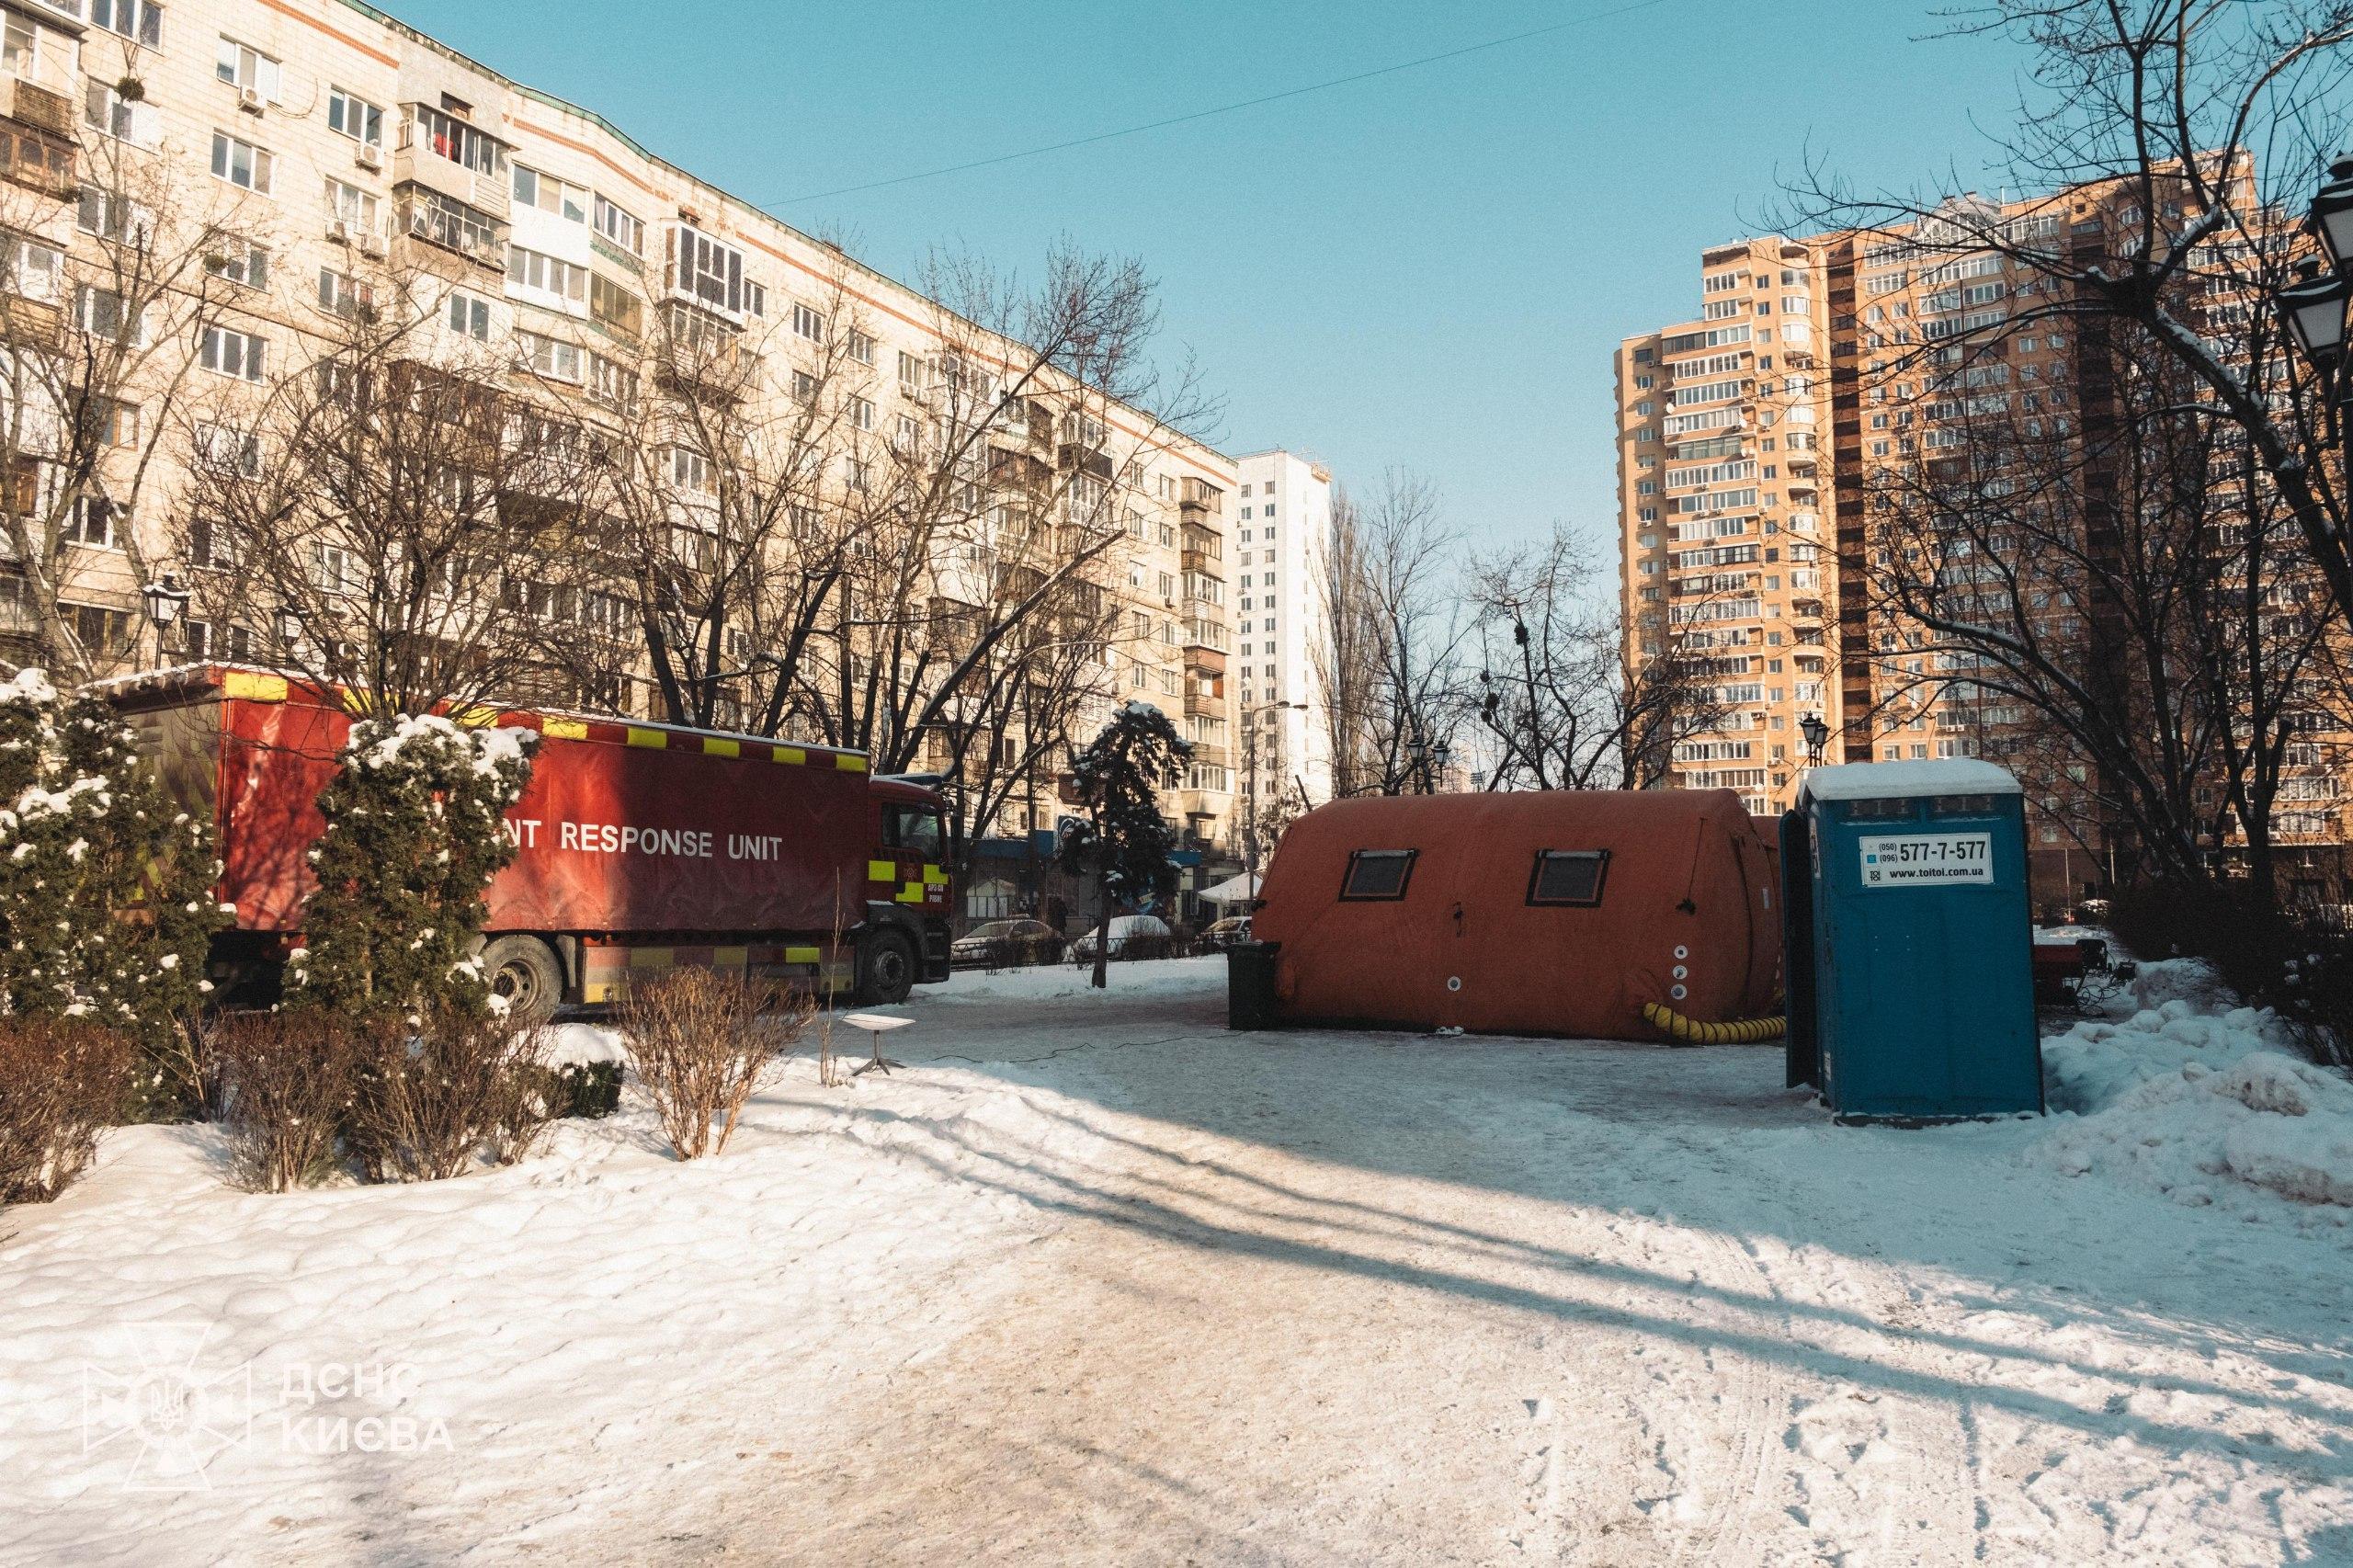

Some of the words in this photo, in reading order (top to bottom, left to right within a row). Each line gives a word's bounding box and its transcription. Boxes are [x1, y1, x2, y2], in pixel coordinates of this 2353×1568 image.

[561, 821, 712, 858] RESPONSE
[728, 834, 782, 861] UNIT
[1879, 843, 1897, 852] (050)
[1900, 841, 1985, 861] 577-7-577
[1880, 854, 1898, 864] (096)
[1890, 868, 1984, 878] www.toitoi.com.ua
